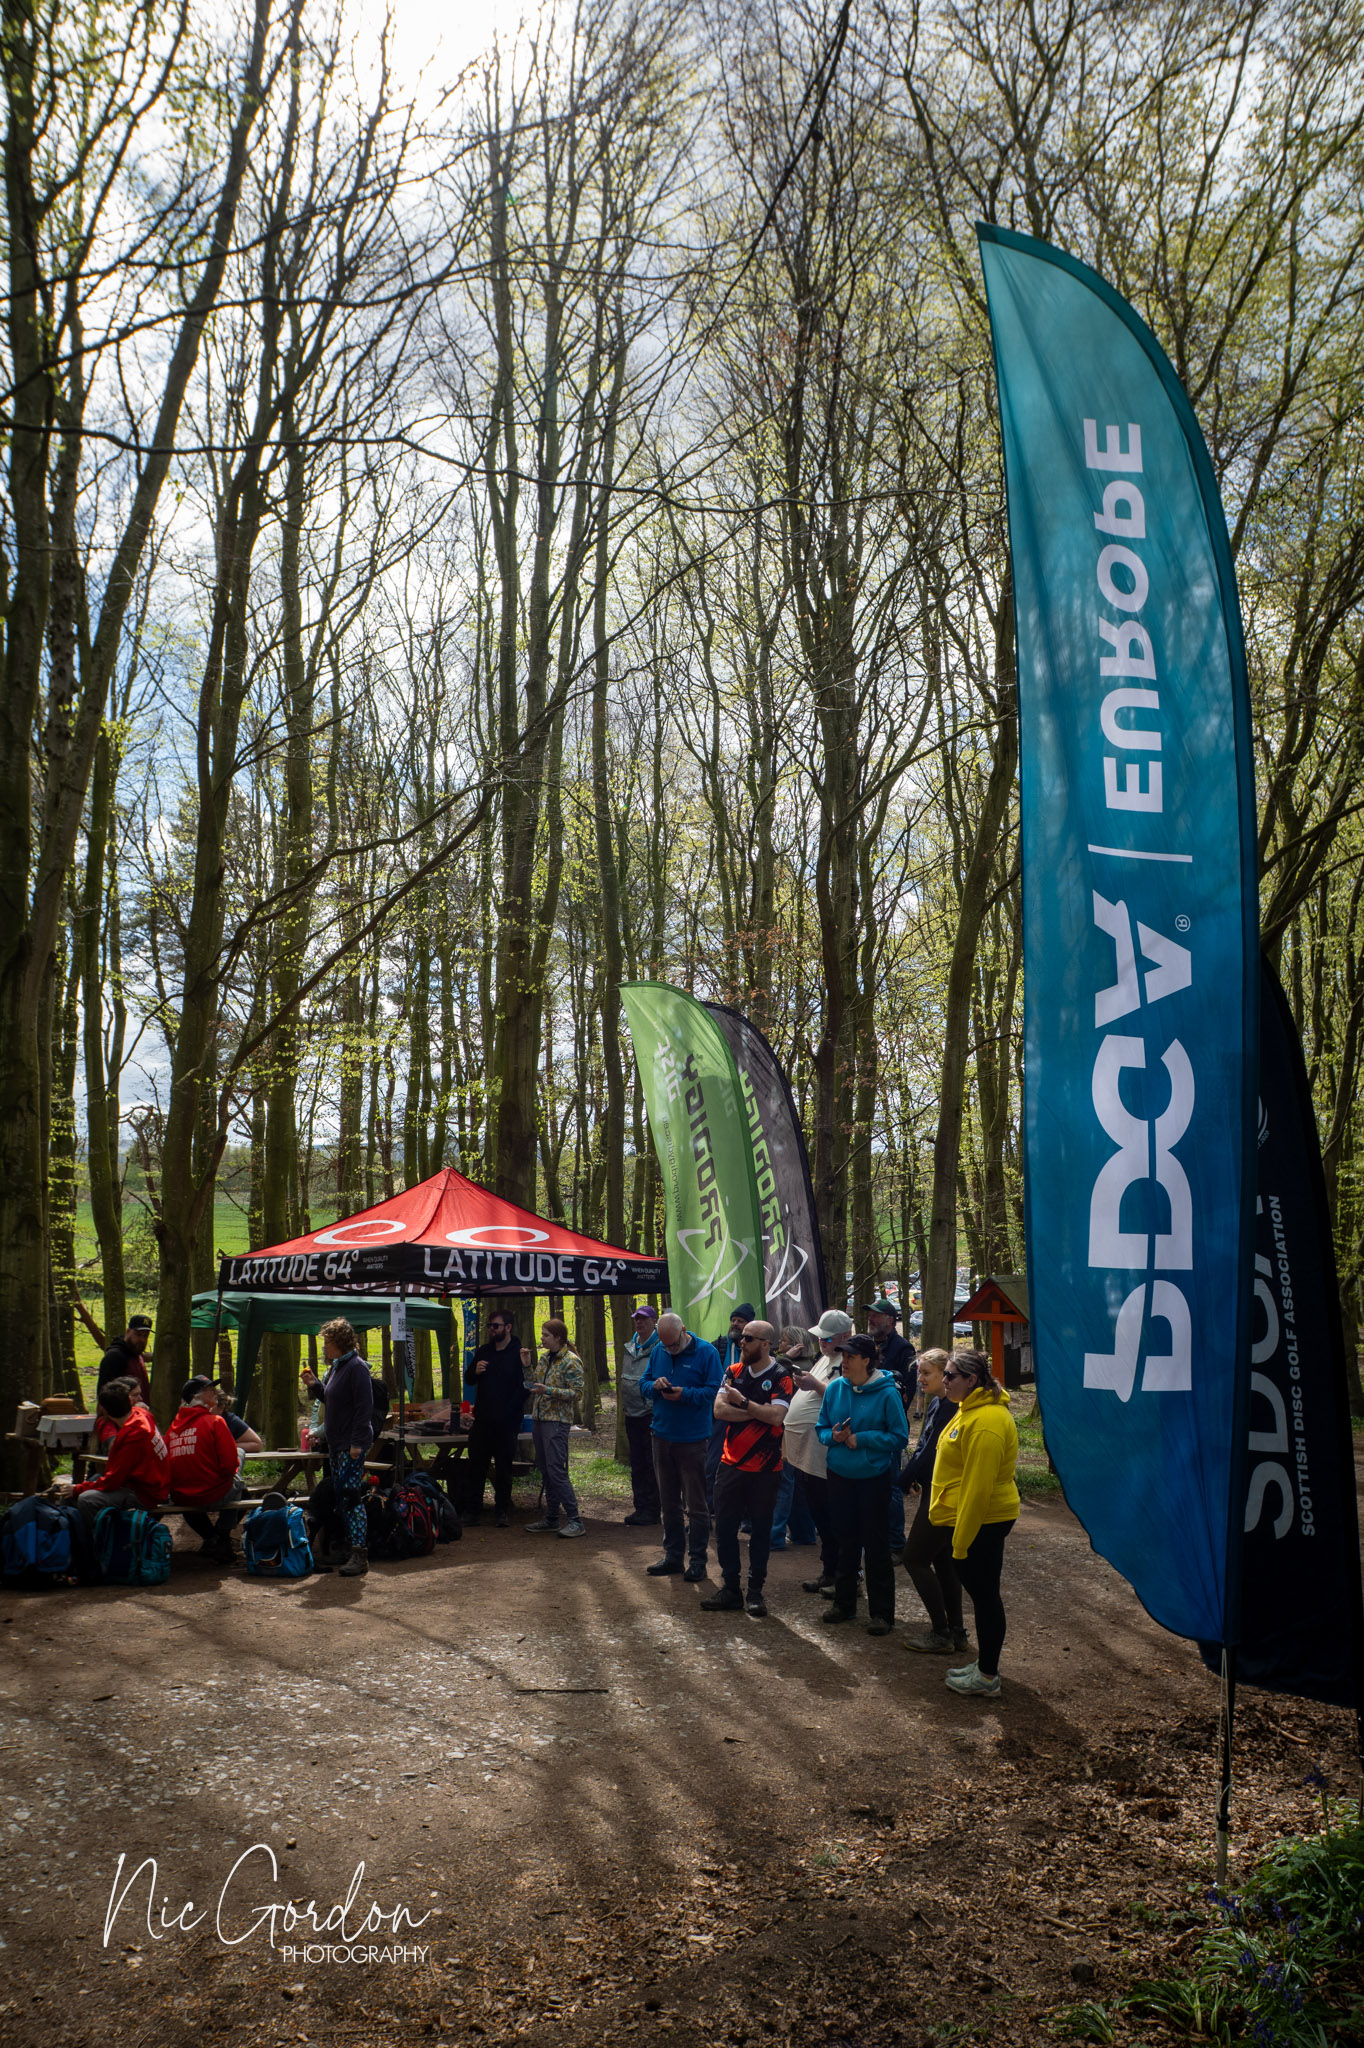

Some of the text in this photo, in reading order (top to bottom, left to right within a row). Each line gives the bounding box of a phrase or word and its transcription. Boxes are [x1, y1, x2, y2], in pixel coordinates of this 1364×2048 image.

[228, 1253, 321, 1286] LATITUDE
[423, 1247, 575, 1283] LATITUDE
[1268, 1195, 1316, 1536] SCOTTISH DISC GOLF ASSOCIATION
